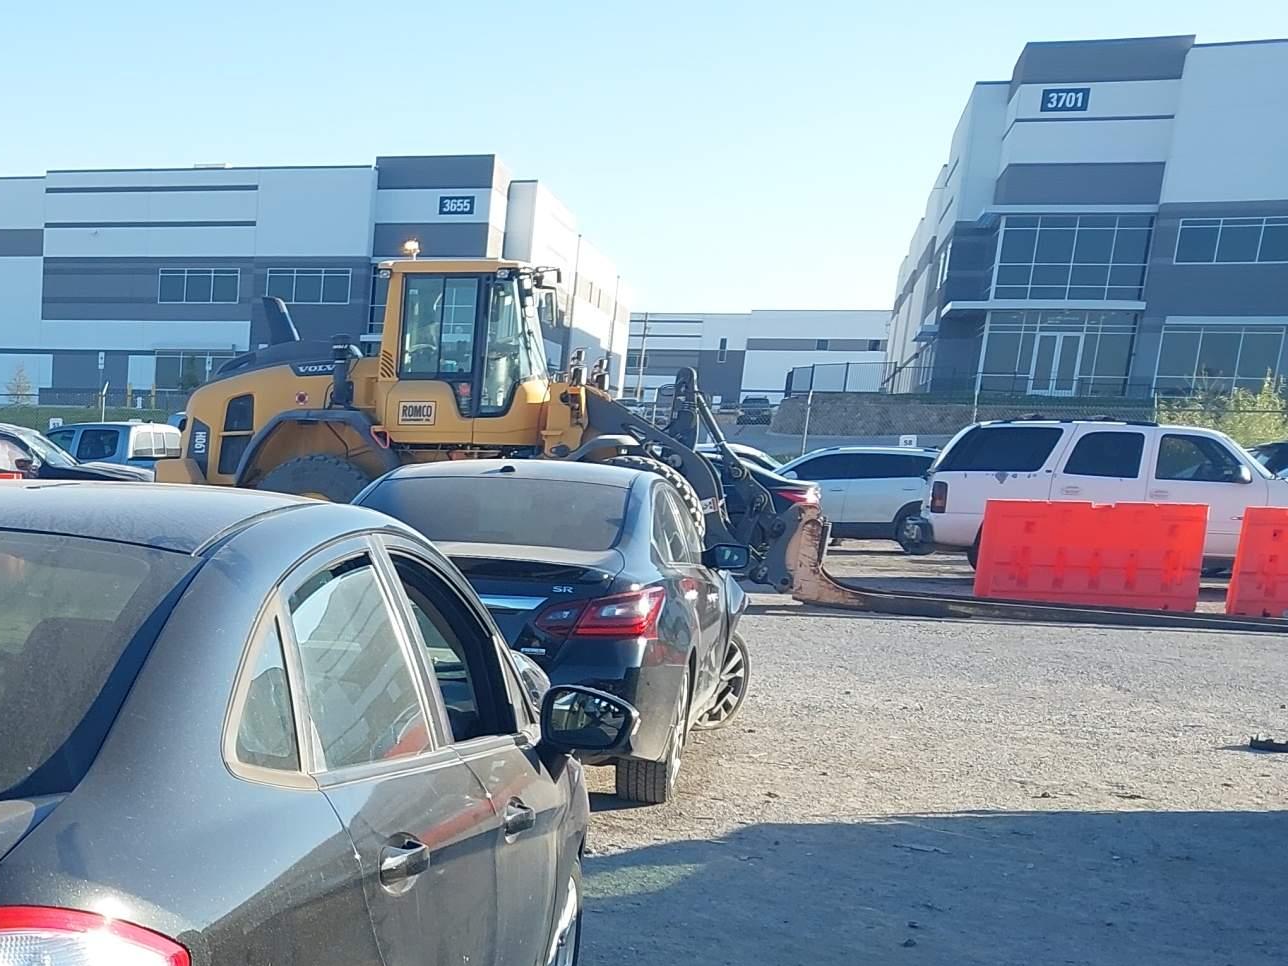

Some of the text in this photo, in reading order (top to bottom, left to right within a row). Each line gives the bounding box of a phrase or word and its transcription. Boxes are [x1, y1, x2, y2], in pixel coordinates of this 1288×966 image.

[1047, 92, 1084, 108] 3701
[442, 199, 471, 212] 3655
[297, 365, 336, 373] VOLV
[402, 405, 432, 418] ROMCO
[194, 431, 207, 454] L90H
[552, 584, 574, 594] SR
